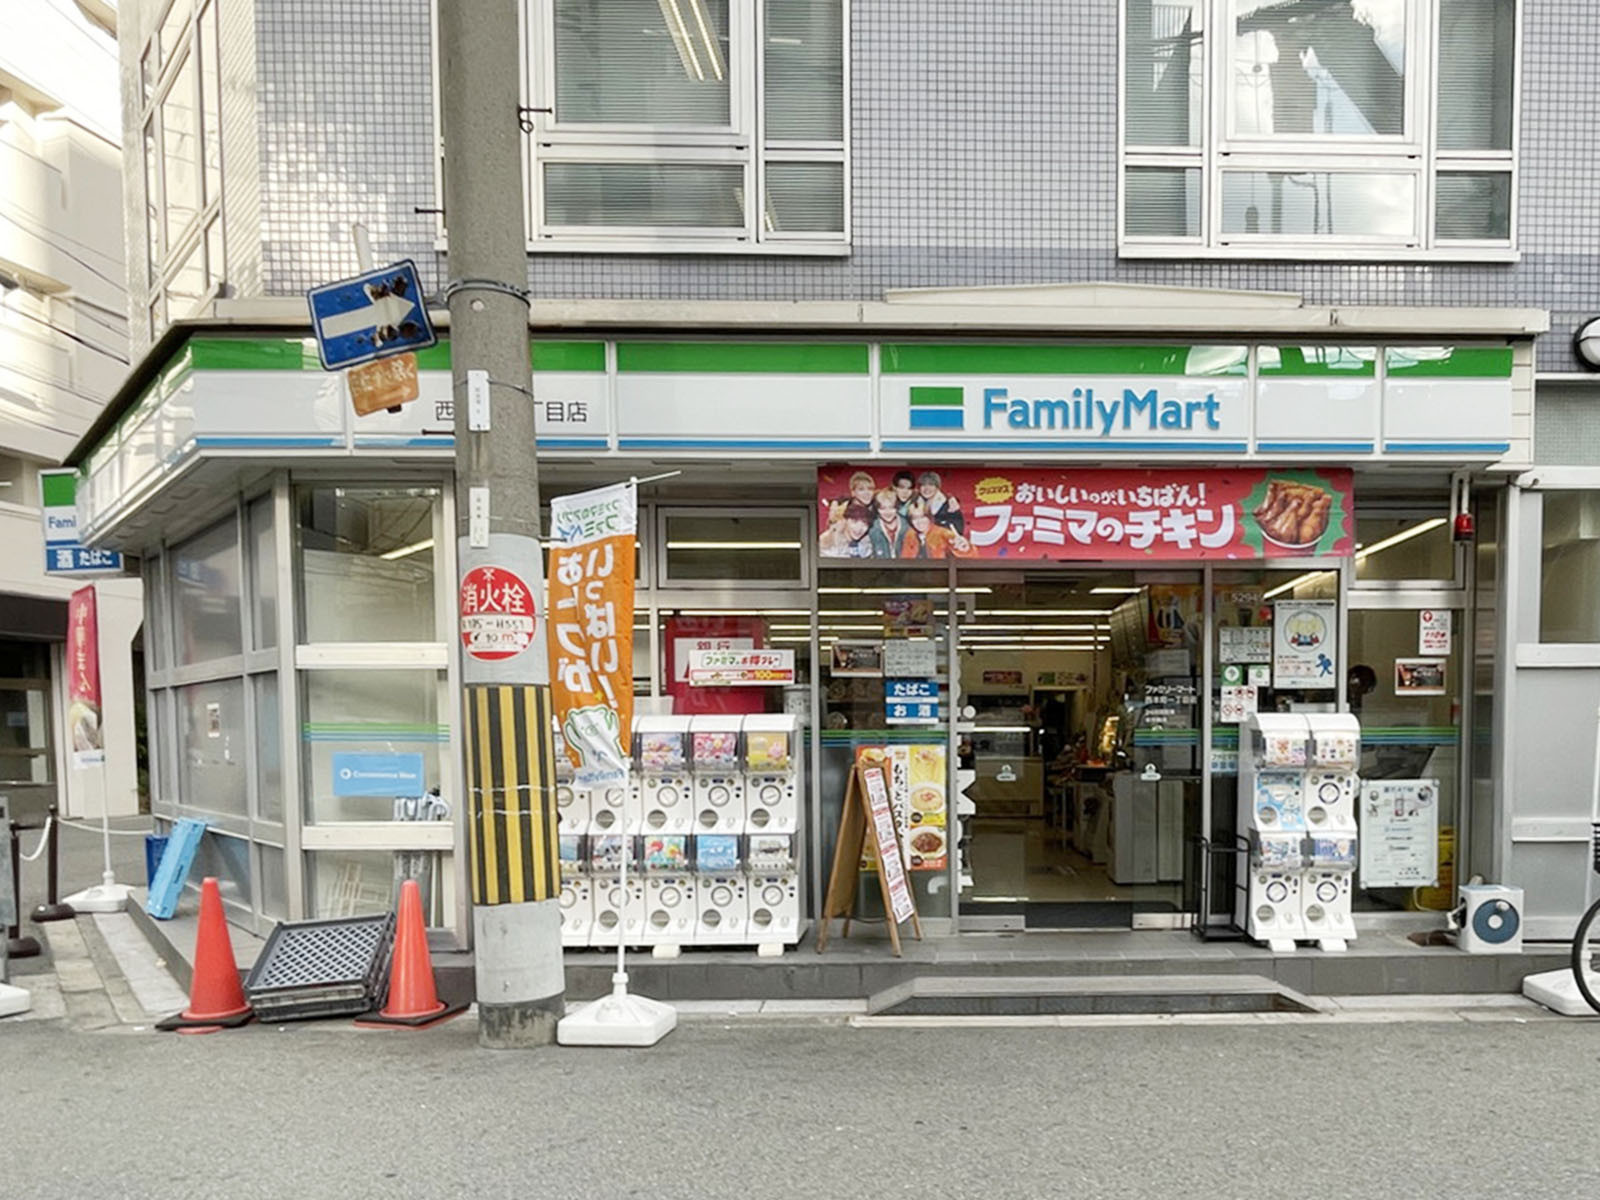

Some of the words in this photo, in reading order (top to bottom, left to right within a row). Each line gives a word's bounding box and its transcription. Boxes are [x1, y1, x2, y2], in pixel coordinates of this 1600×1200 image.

[983, 388, 1221, 436] FamilyMart
[970, 504, 1235, 549] ファミマのチキン
[56, 549, 74, 568] 酒
[79, 549, 113, 566] たばこ
[463, 582, 525, 613] 消火栓
[893, 683, 931, 697] たばこ
